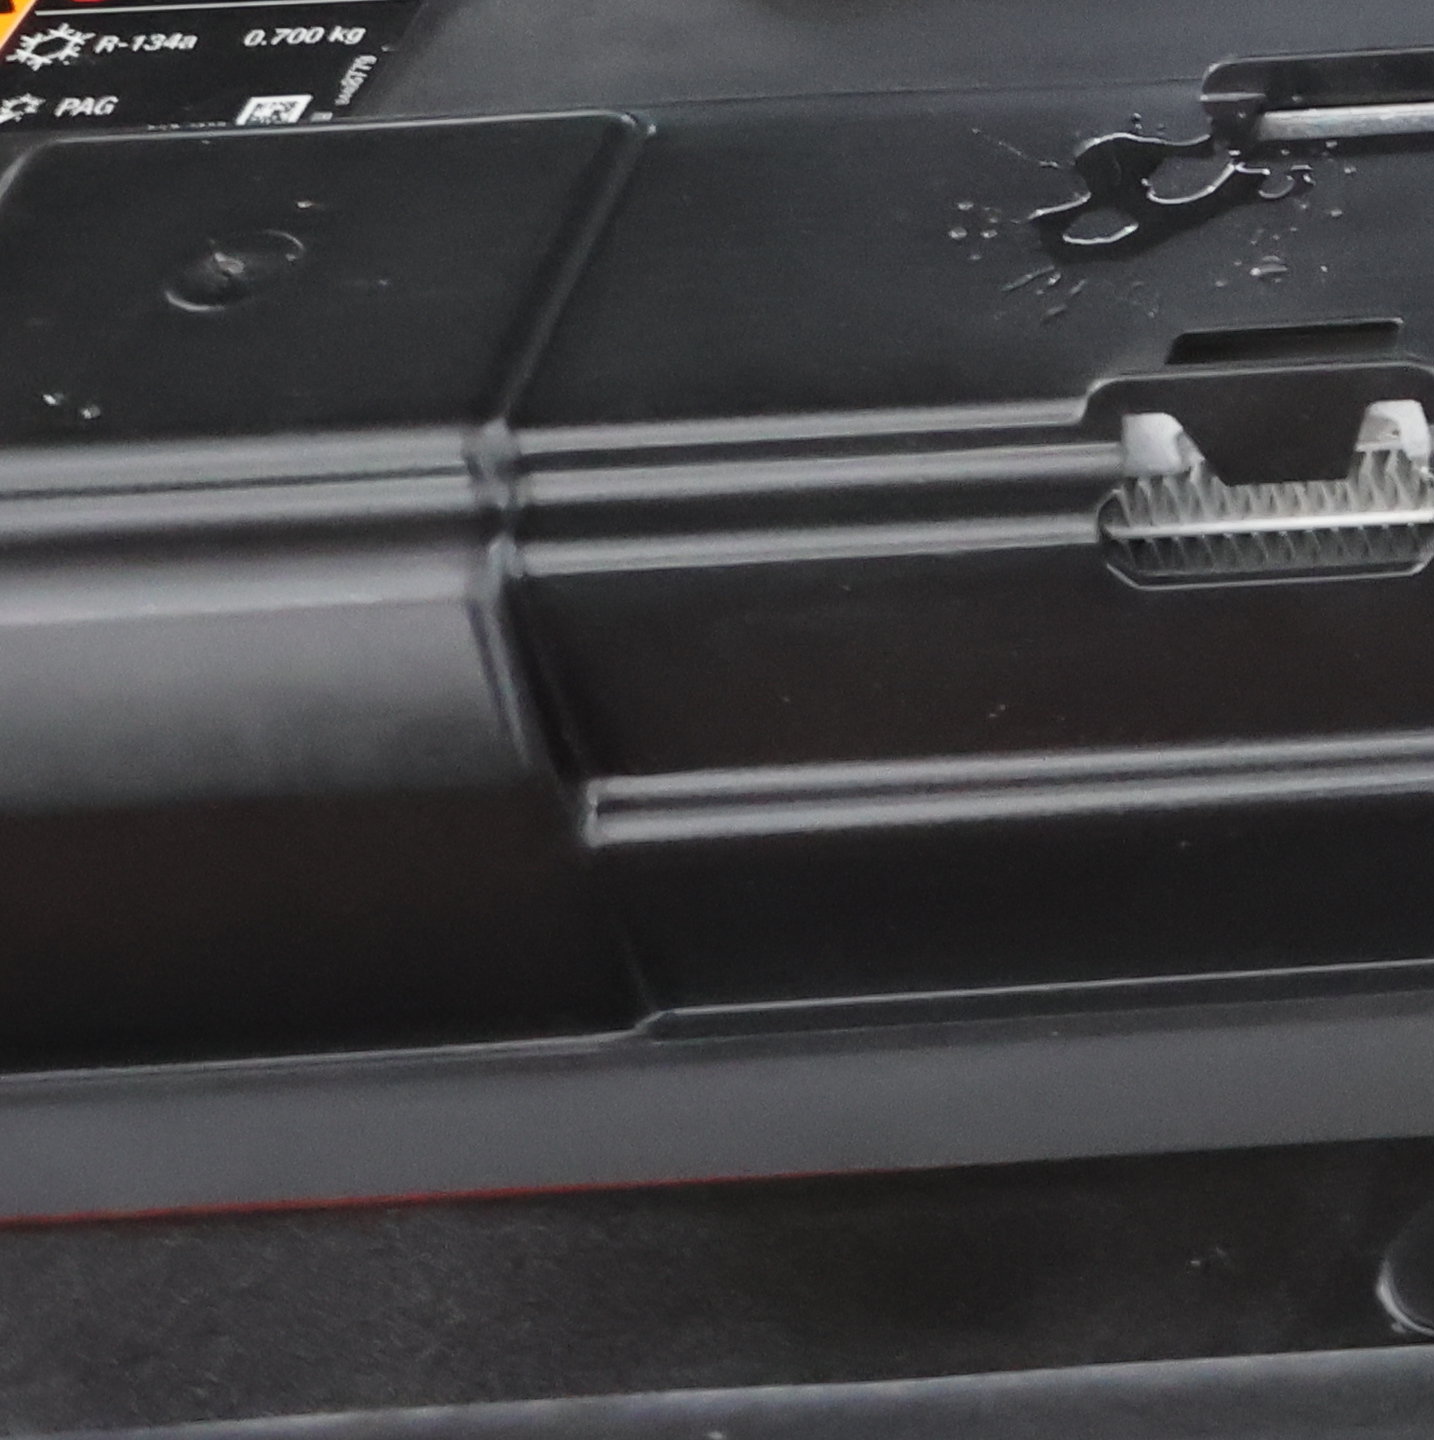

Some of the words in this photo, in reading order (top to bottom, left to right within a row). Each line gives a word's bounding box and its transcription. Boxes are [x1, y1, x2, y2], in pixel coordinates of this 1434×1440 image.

[95, 32, 198, 53] R-134a
[243, 27, 325, 48] 0.700
[328, 25, 366, 46] kg
[54, 95, 118, 118] PAG
